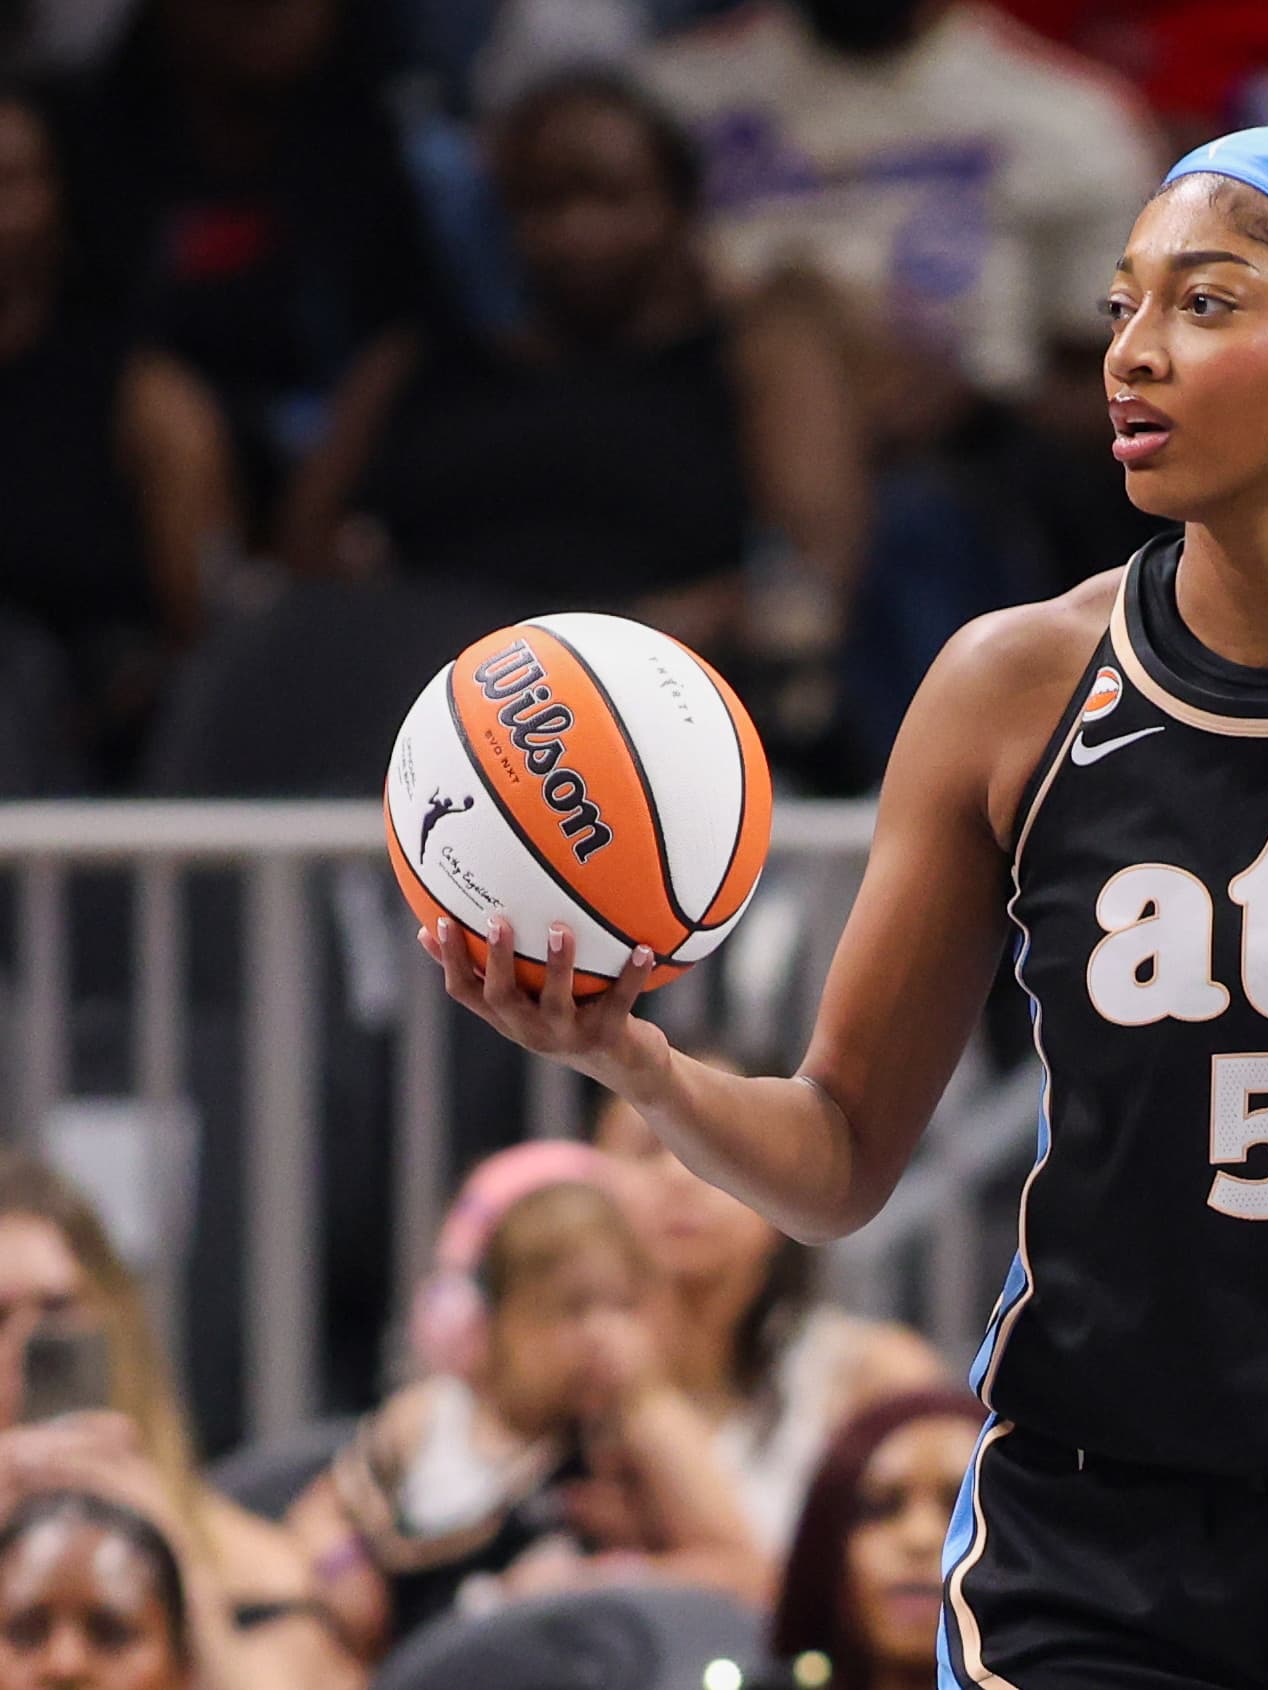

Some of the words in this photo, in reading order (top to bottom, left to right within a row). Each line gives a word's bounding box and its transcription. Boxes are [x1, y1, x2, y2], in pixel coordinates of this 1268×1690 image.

[474, 637, 614, 864] Wilson
[485, 730, 502, 756] EVO
[501, 758, 520, 783] NXT
